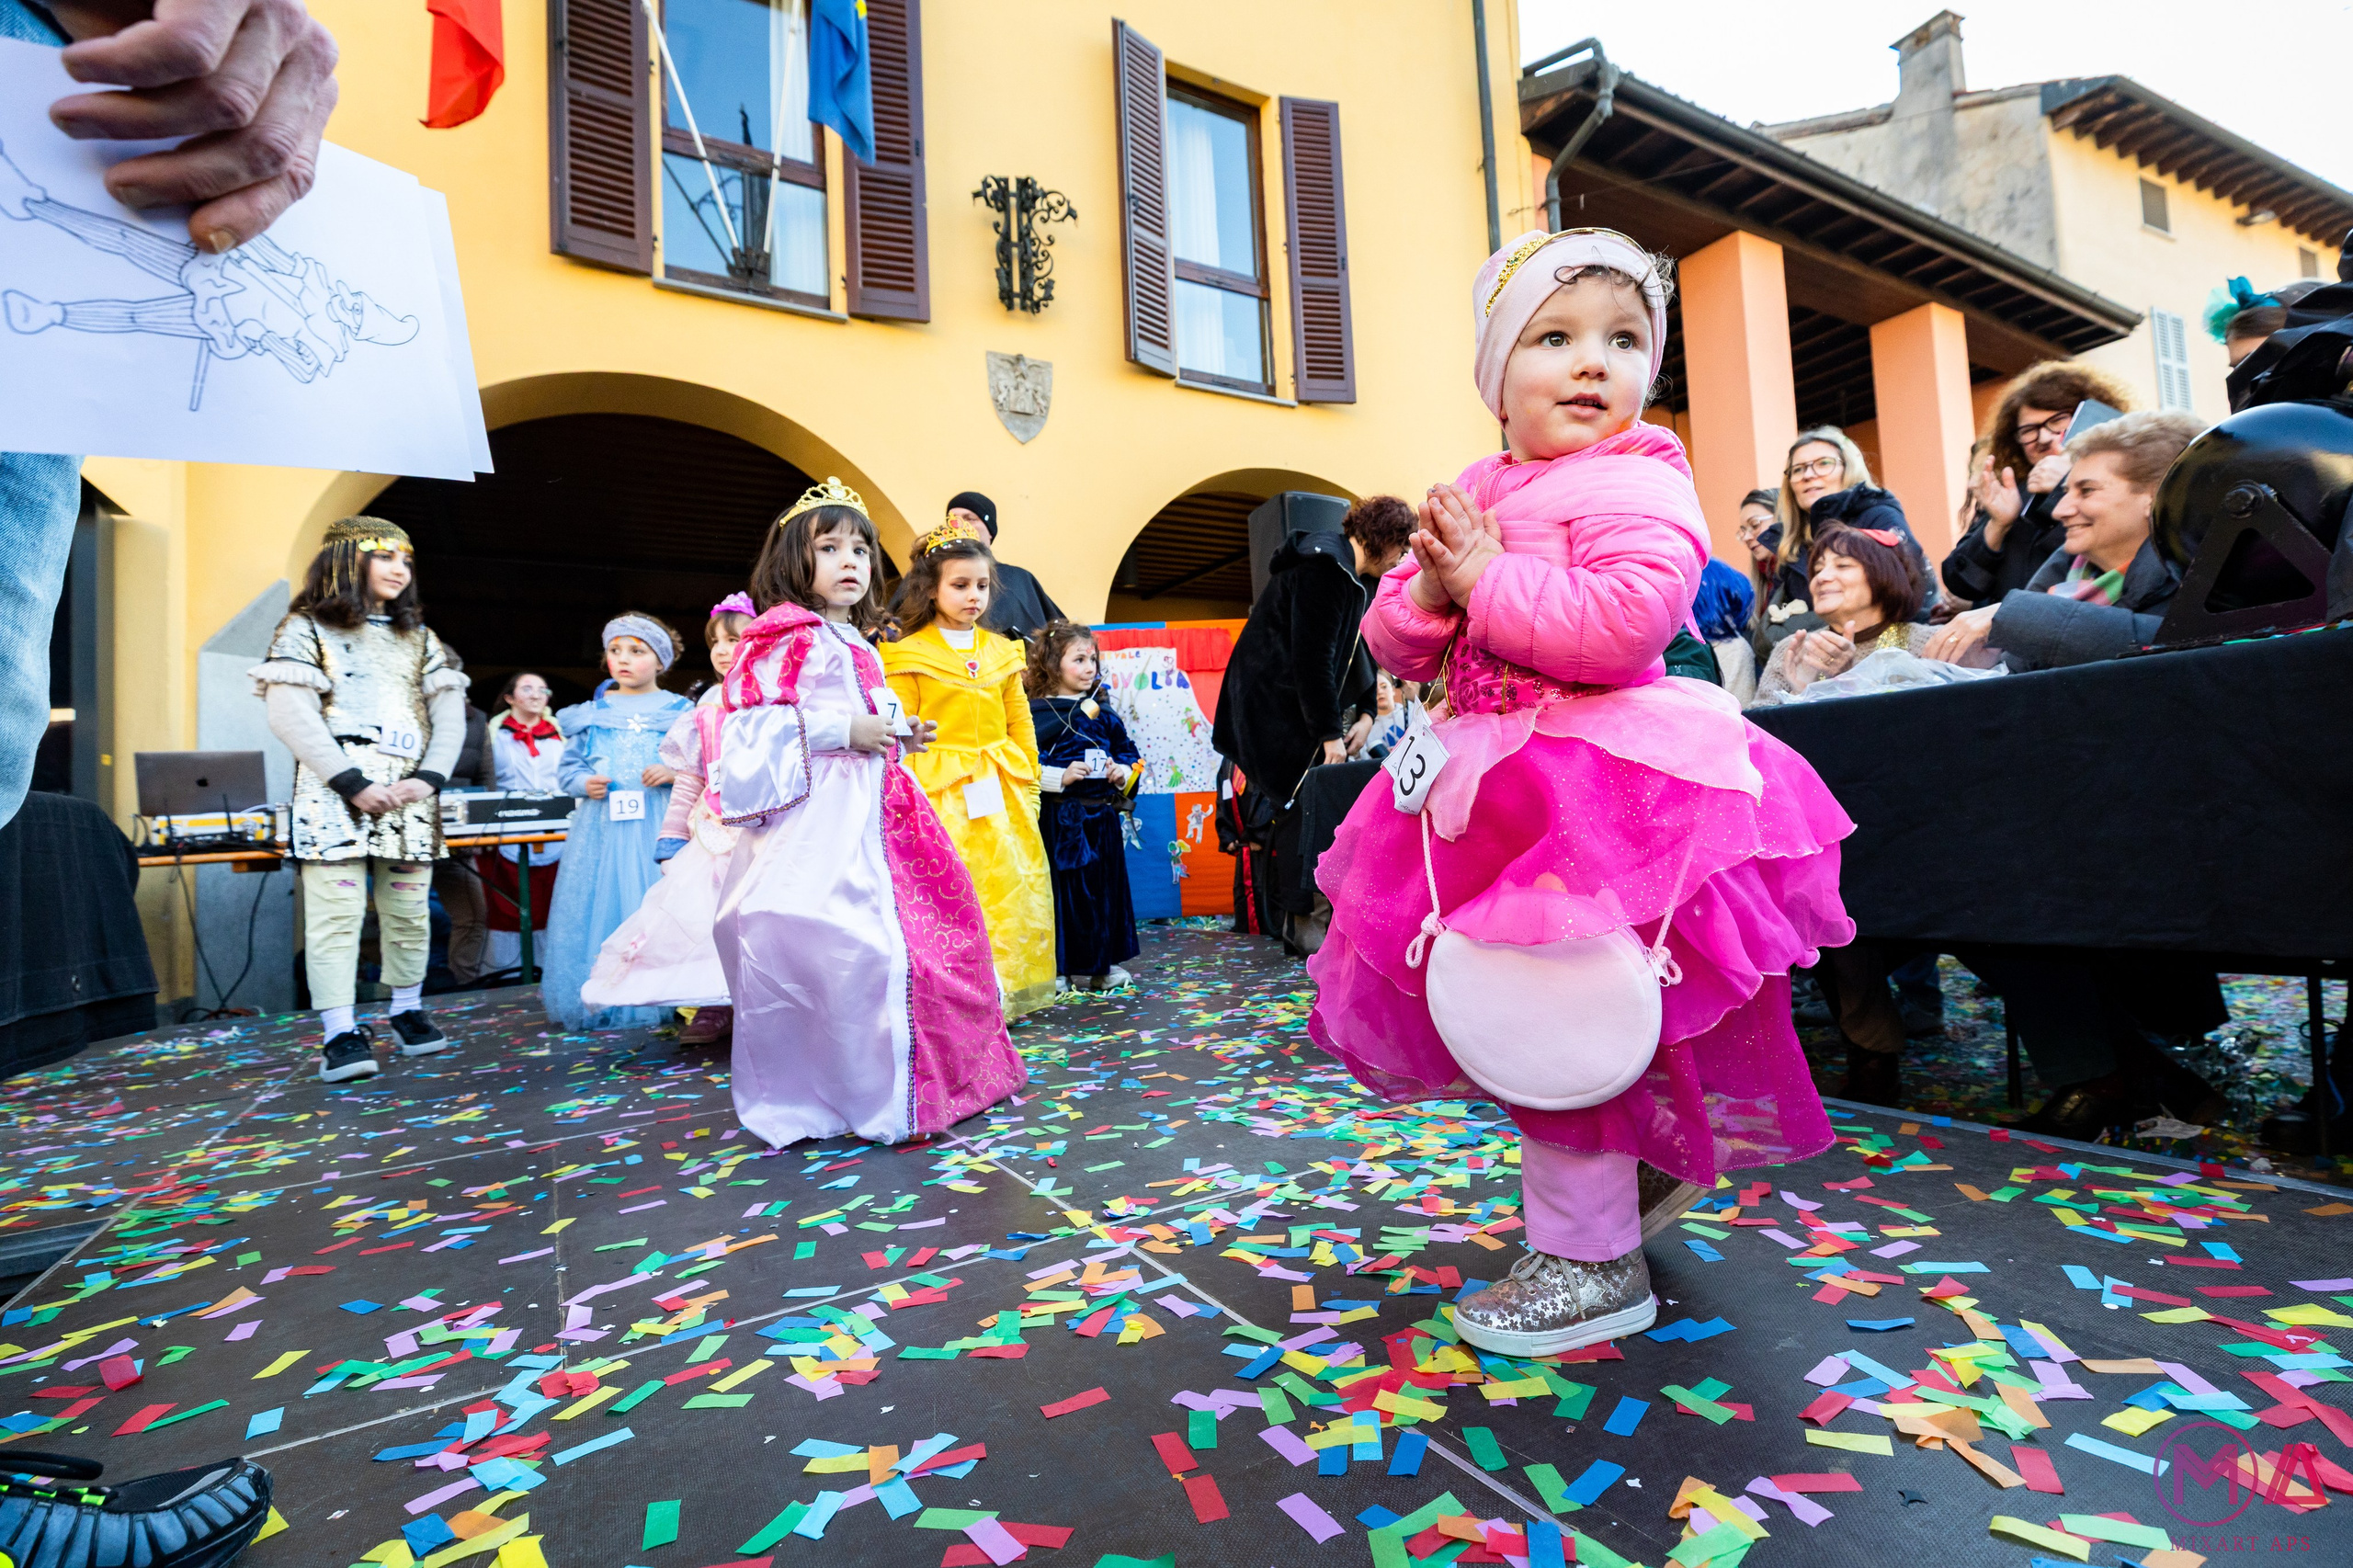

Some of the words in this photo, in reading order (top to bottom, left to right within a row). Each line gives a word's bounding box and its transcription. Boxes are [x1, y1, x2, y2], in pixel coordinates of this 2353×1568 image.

[1095, 670, 1189, 690] IVOLTA
[888, 702, 897, 720] 7
[388, 731, 415, 750] 10
[1092, 757, 1108, 772] 17
[1397, 735, 1427, 797] 13
[616, 799, 639, 814] 19
